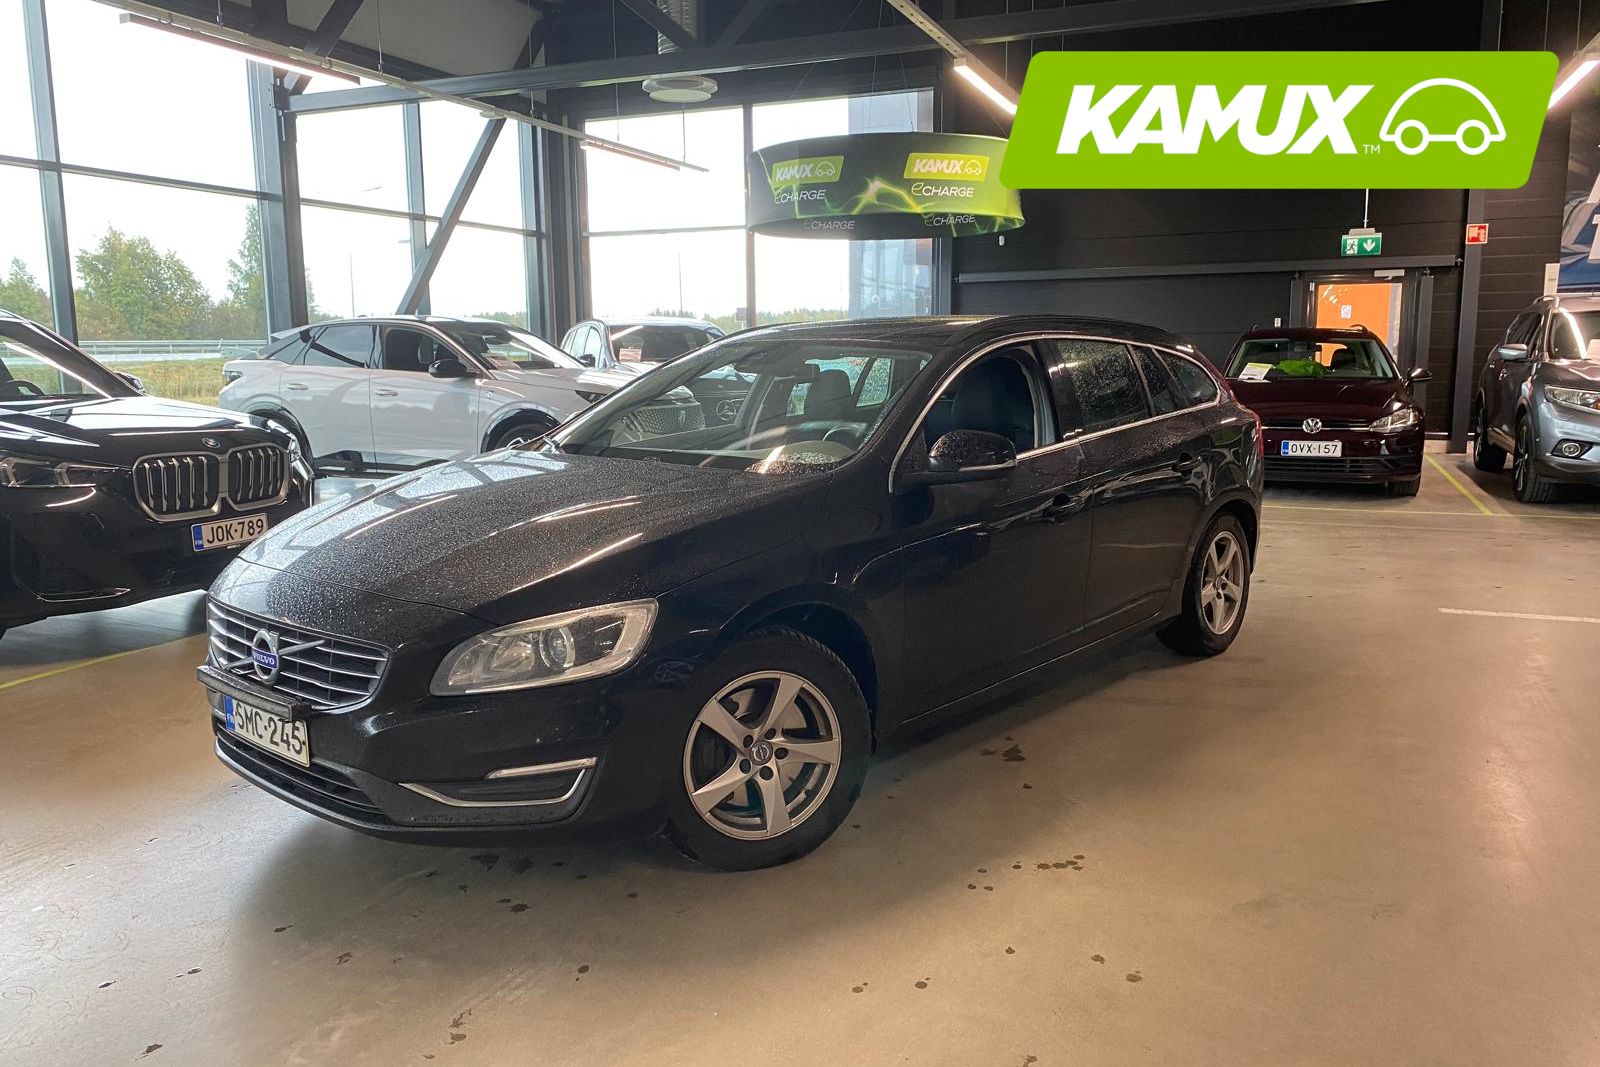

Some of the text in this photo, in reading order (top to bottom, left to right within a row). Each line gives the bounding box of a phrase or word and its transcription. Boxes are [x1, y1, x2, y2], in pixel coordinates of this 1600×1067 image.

[775, 163, 813, 182] KAMUX
[913, 158, 965, 175] KAMUX
[252, 650, 275, 665] VOLVO
